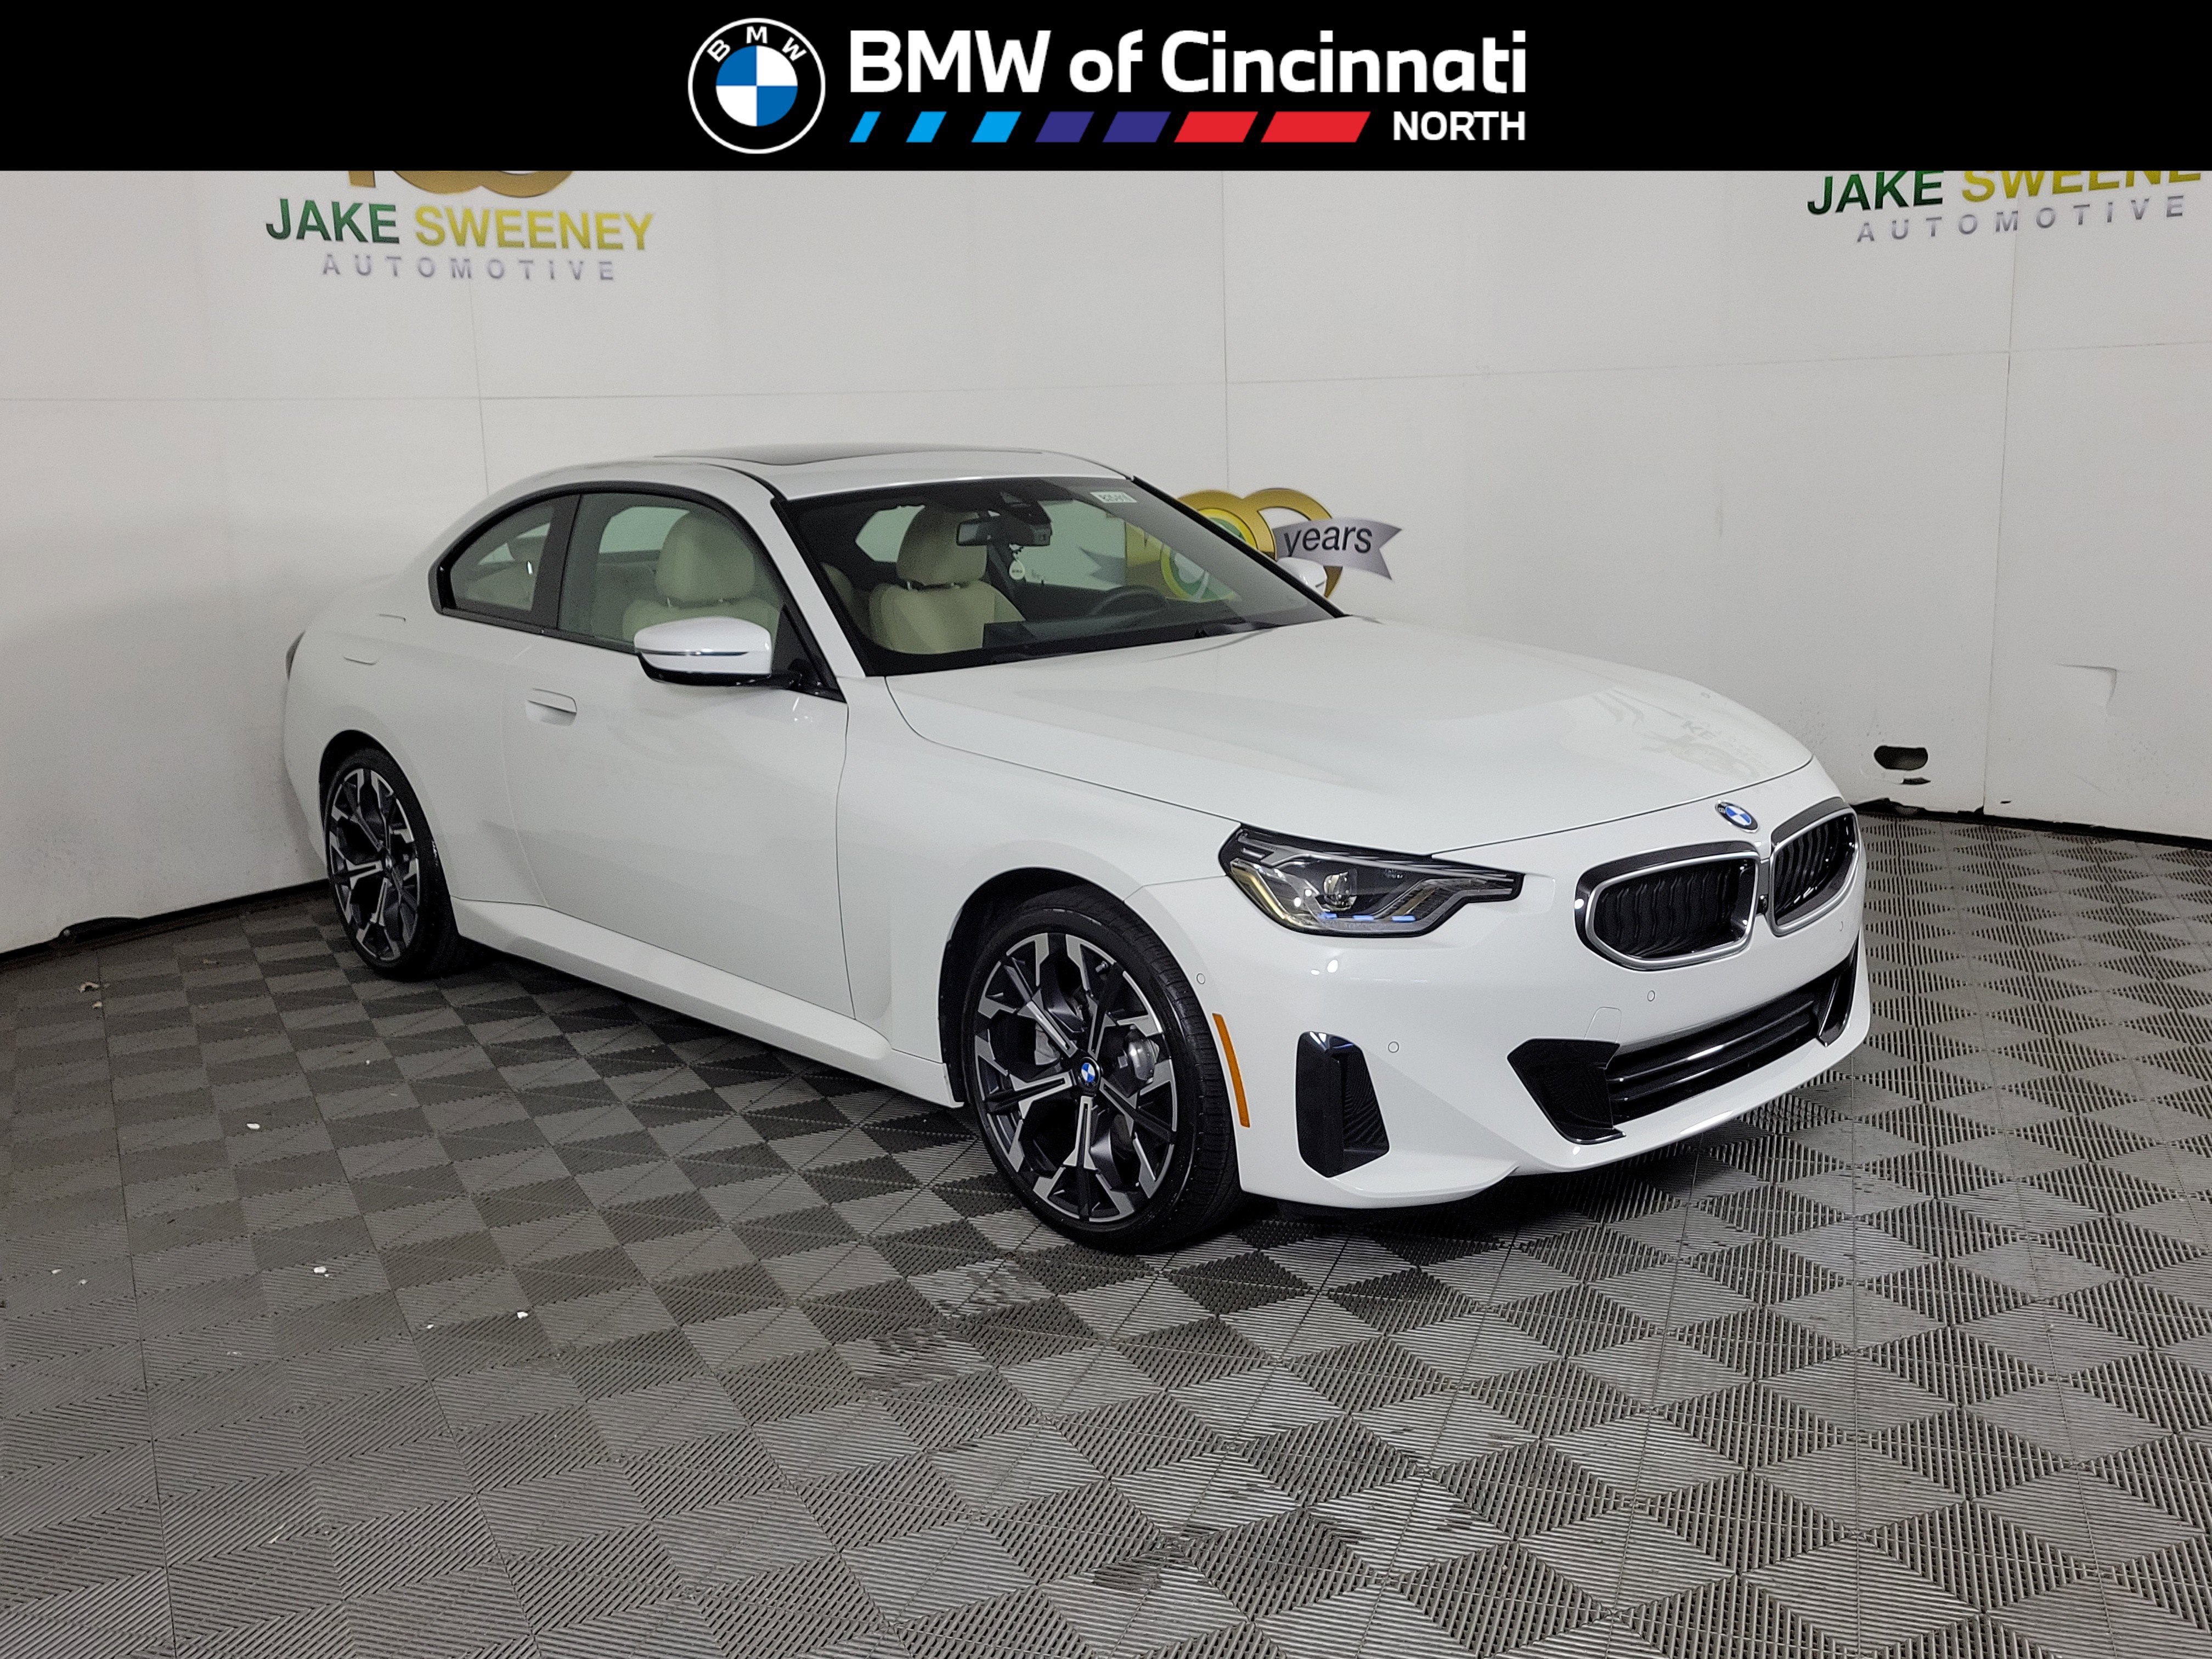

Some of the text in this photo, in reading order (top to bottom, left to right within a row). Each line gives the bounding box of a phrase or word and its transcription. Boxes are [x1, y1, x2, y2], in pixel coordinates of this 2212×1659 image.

[1807, 171, 1944, 215] JAKE
[266, 198, 653, 251] JAKE SWEENEY
[1857, 195, 2185, 242] AUTOMOTIVE
[322, 253, 614, 281] AUTOMOTIVE
[1283, 525, 1373, 557] years
